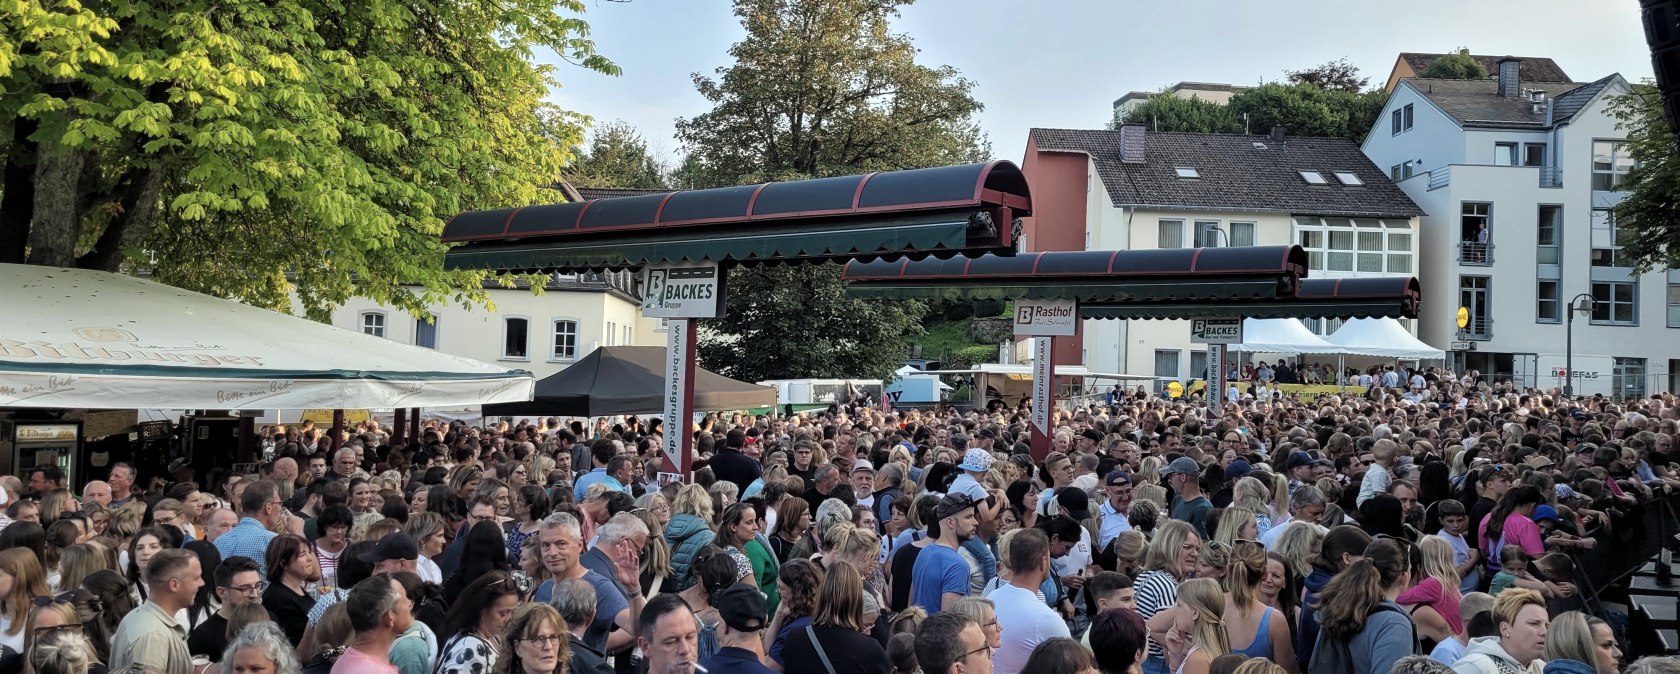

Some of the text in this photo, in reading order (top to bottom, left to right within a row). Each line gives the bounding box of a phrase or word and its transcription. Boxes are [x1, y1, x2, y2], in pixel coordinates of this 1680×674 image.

[665, 283, 713, 300] BACKES
[664, 301, 682, 309] Gruppe
[1035, 306, 1073, 317] Rasthof
[1206, 326, 1238, 335] BACKES
[48, 375, 77, 389] Bit
[669, 324, 681, 455] www.backesgruppe.de
[1037, 339, 1046, 426] www.meinrasthof.de
[216, 390, 245, 404] Bitte
[269, 380, 293, 393] Bit
